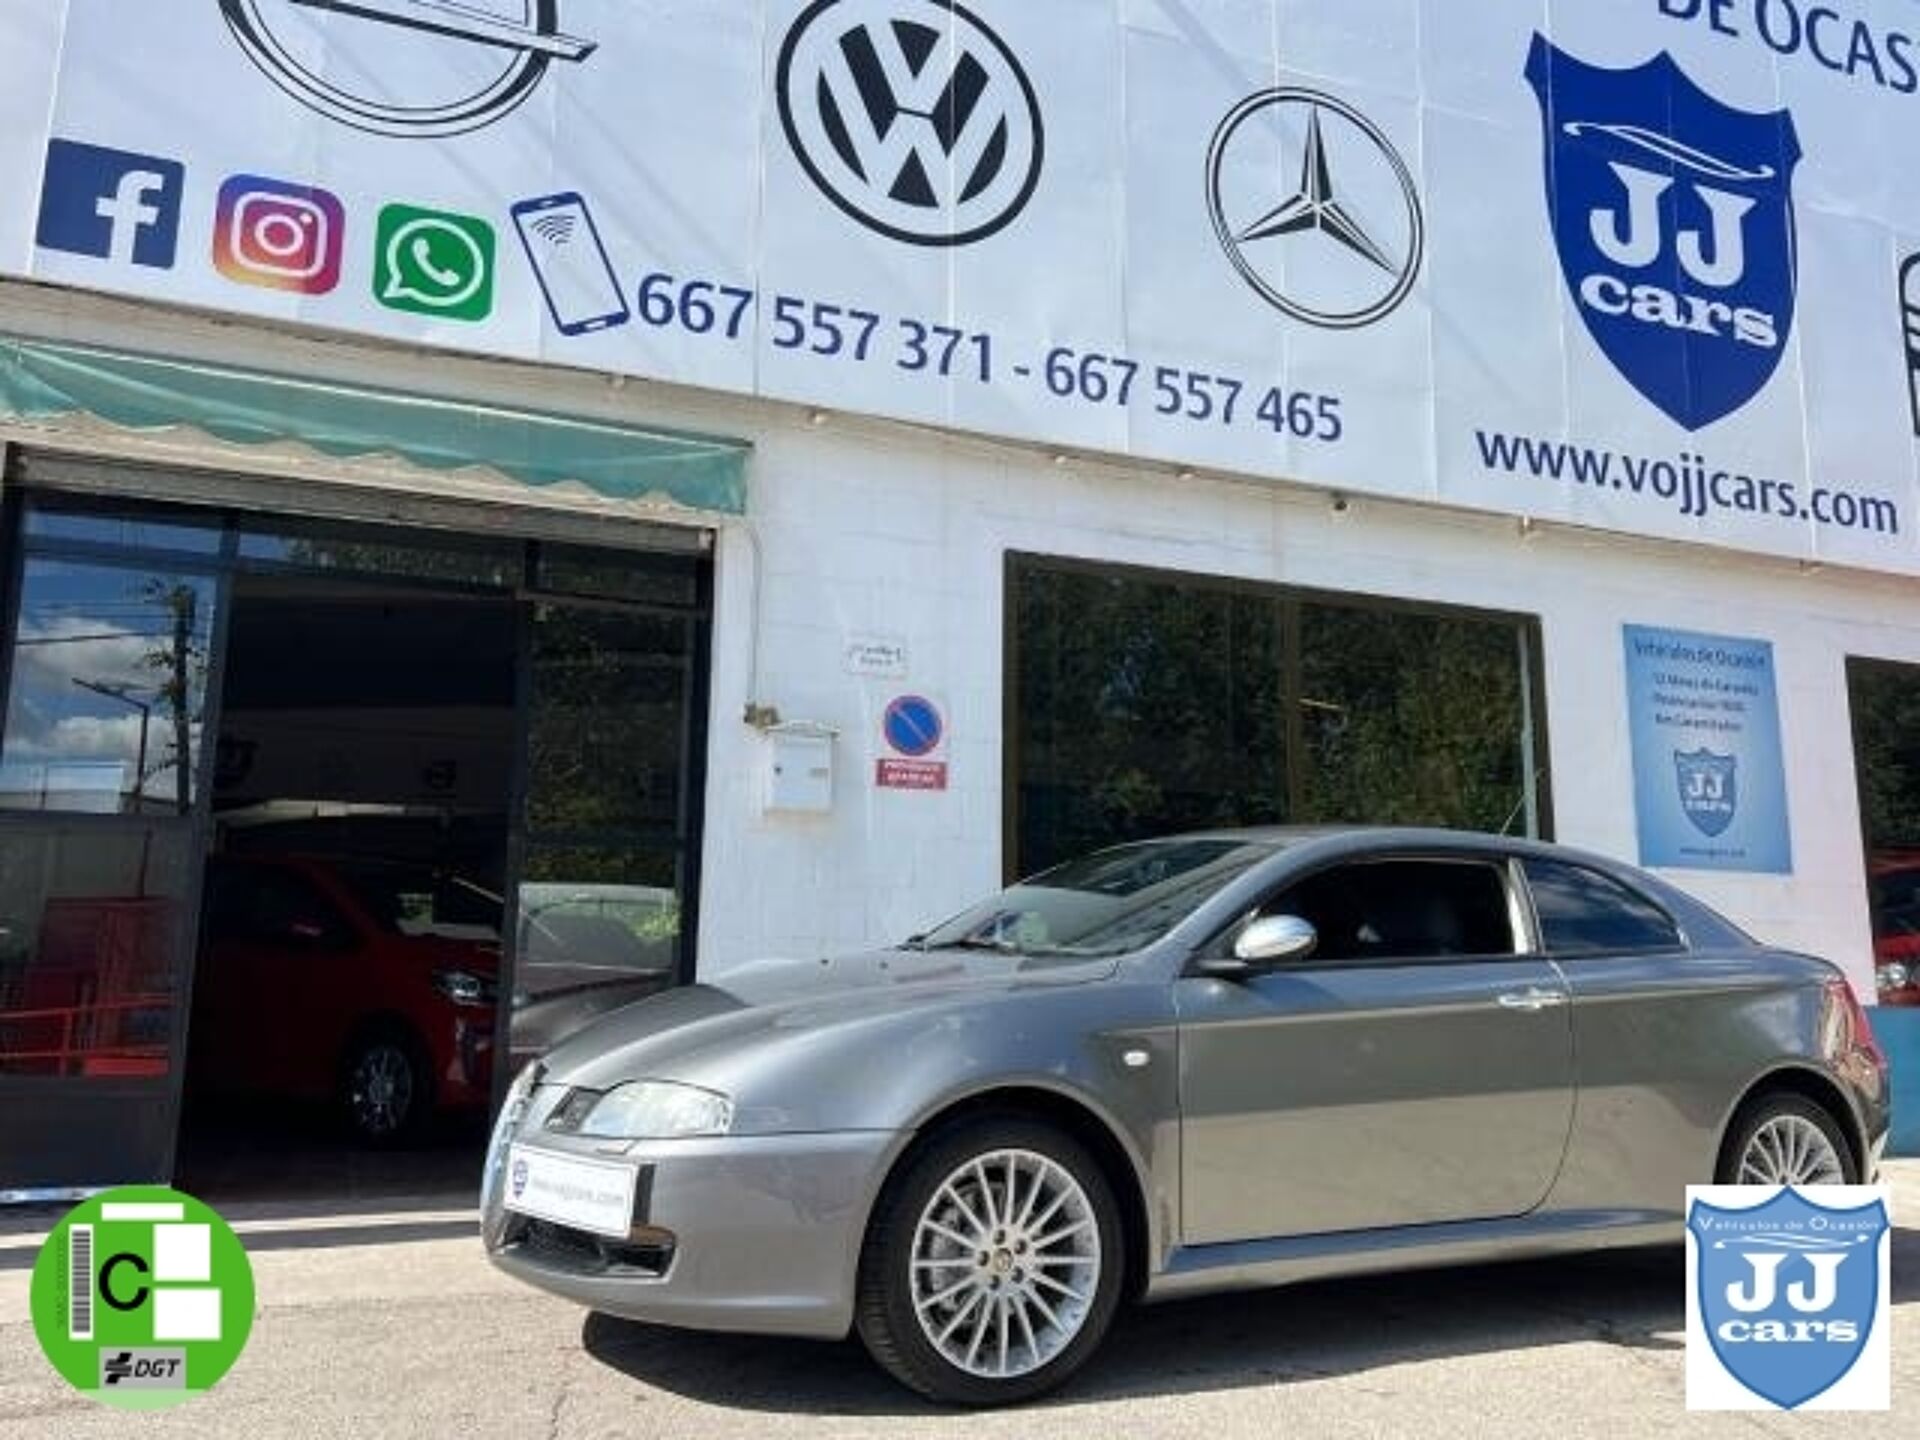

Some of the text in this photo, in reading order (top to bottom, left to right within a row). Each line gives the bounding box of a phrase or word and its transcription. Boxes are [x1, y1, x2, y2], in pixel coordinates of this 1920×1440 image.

[1589, 161, 1757, 286] JJ
[639, 272, 754, 339] 667
[773, 296, 881, 361] 557
[896, 318, 991, 382] 371
[1045, 347, 1139, 406] 667
[1155, 366, 1243, 424] 557
[1256, 386, 1342, 442] 465
[1580, 274, 1778, 348] cars
[1476, 431, 1899, 534] www.vojjcars.com
